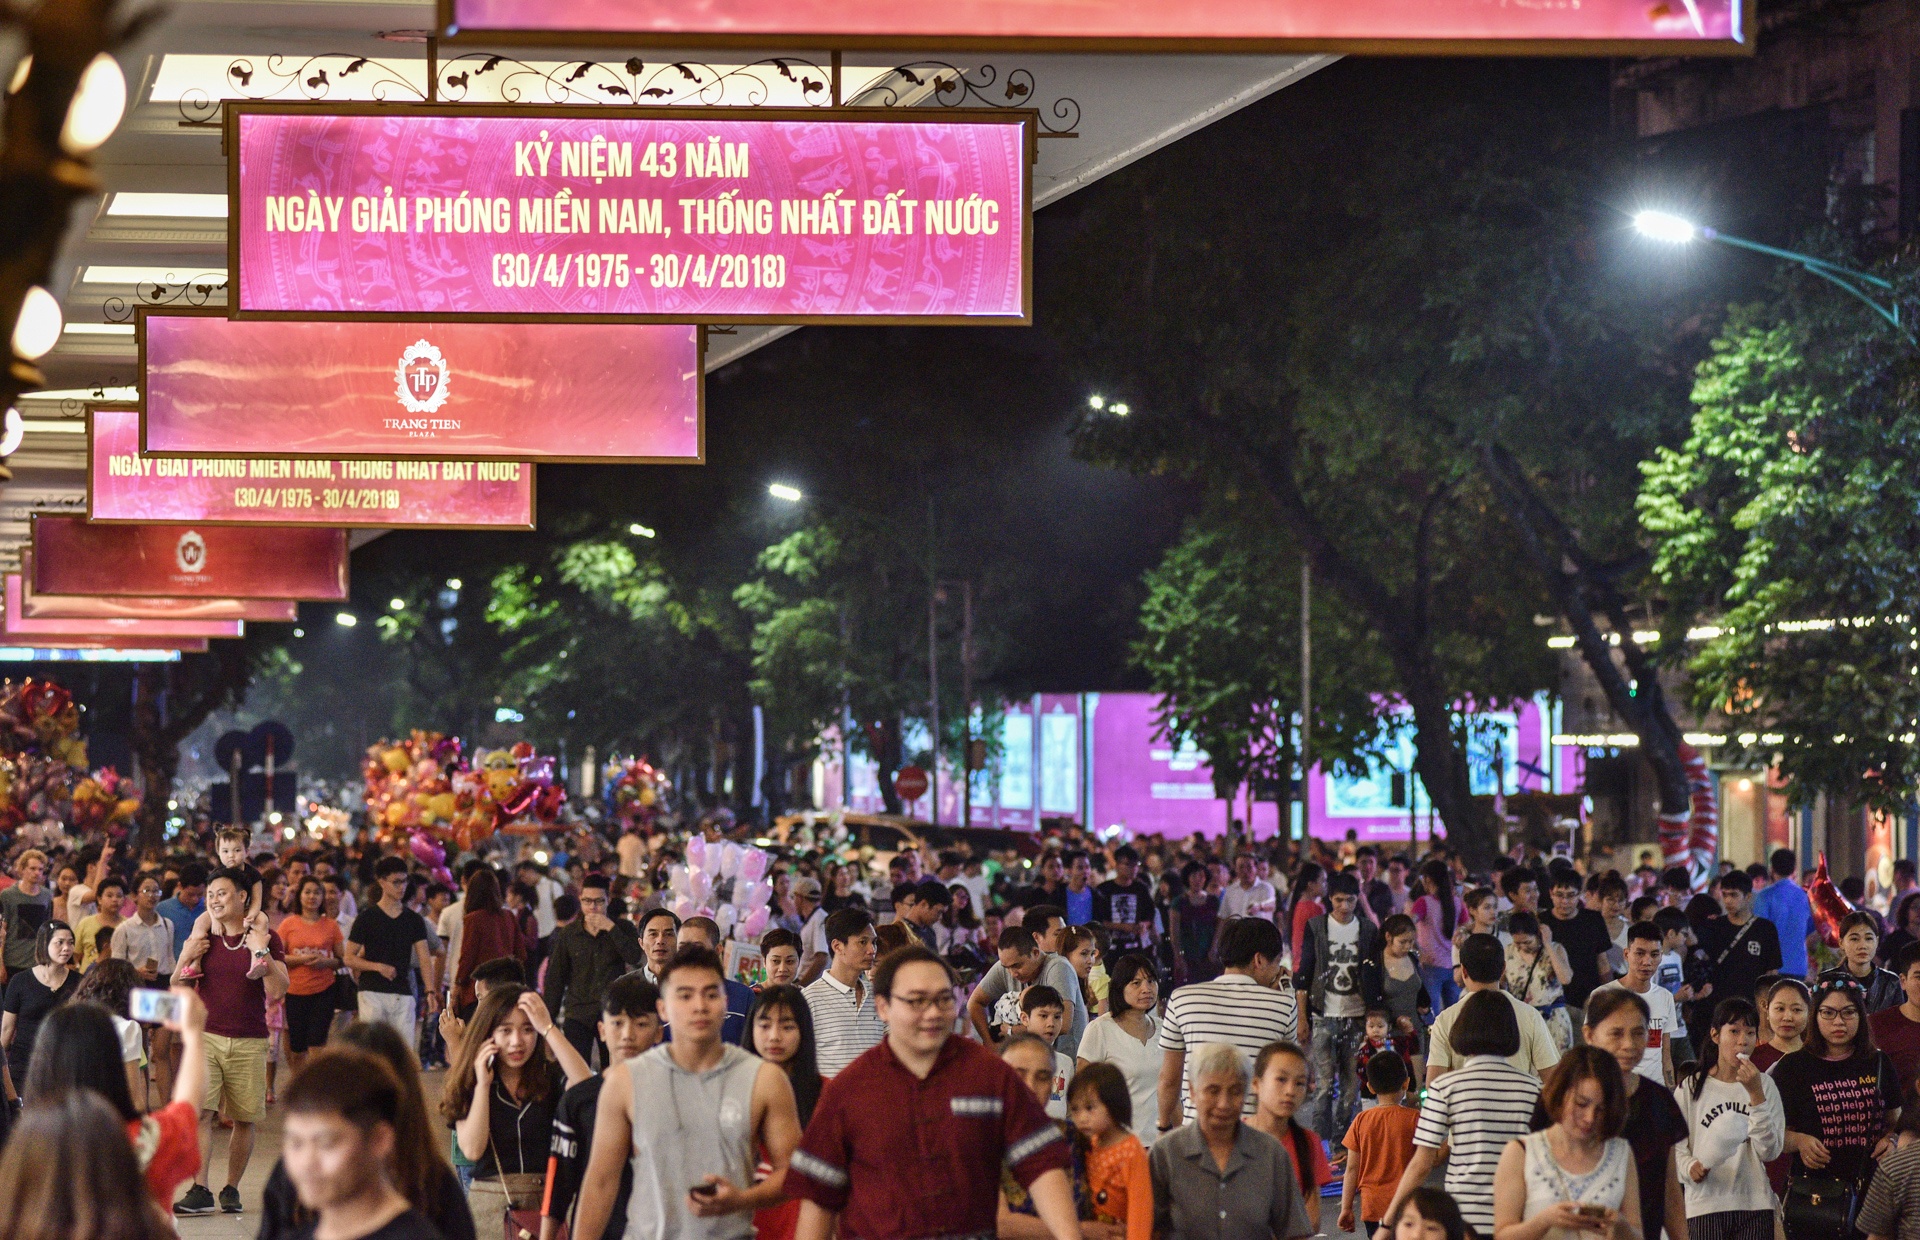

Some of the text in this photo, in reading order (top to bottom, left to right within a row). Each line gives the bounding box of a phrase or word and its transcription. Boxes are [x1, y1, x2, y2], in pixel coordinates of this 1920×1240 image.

[515, 130, 749, 184] KỶ NIỆM 43 NĂM
[266, 186, 999, 239] NGÀY GIẢI PHÓNG MIỀN NAM, THỐNG NHẤT ĐẤT NƯỚC
[492, 253, 630, 288] (30/4/1975
[649, 253, 786, 288] 30/4/2018)
[383, 418, 461, 430] TRANG TIEN
[294, 459, 336, 482] NAM,
[235, 487, 312, 508] (30/4/1975
[323, 489, 399, 509] 30/4/2018)
[1811, 1081, 1834, 1093] Help
[1834, 1078, 1857, 1089] Help
[1815, 1092, 1838, 1102] Help
[1838, 1089, 1861, 1100] Help
[1817, 1103, 1840, 1113] Help
[1842, 1100, 1865, 1111] Help
[1701, 1102, 1751, 1128] EAST VILL
[1821, 1114, 1842, 1124] Help
[1844, 1112, 1866, 1122] Help
[1823, 1126, 1843, 1136] Help
[1845, 1124, 1866, 1134] Help
[1845, 1136, 1867, 1147] Help
